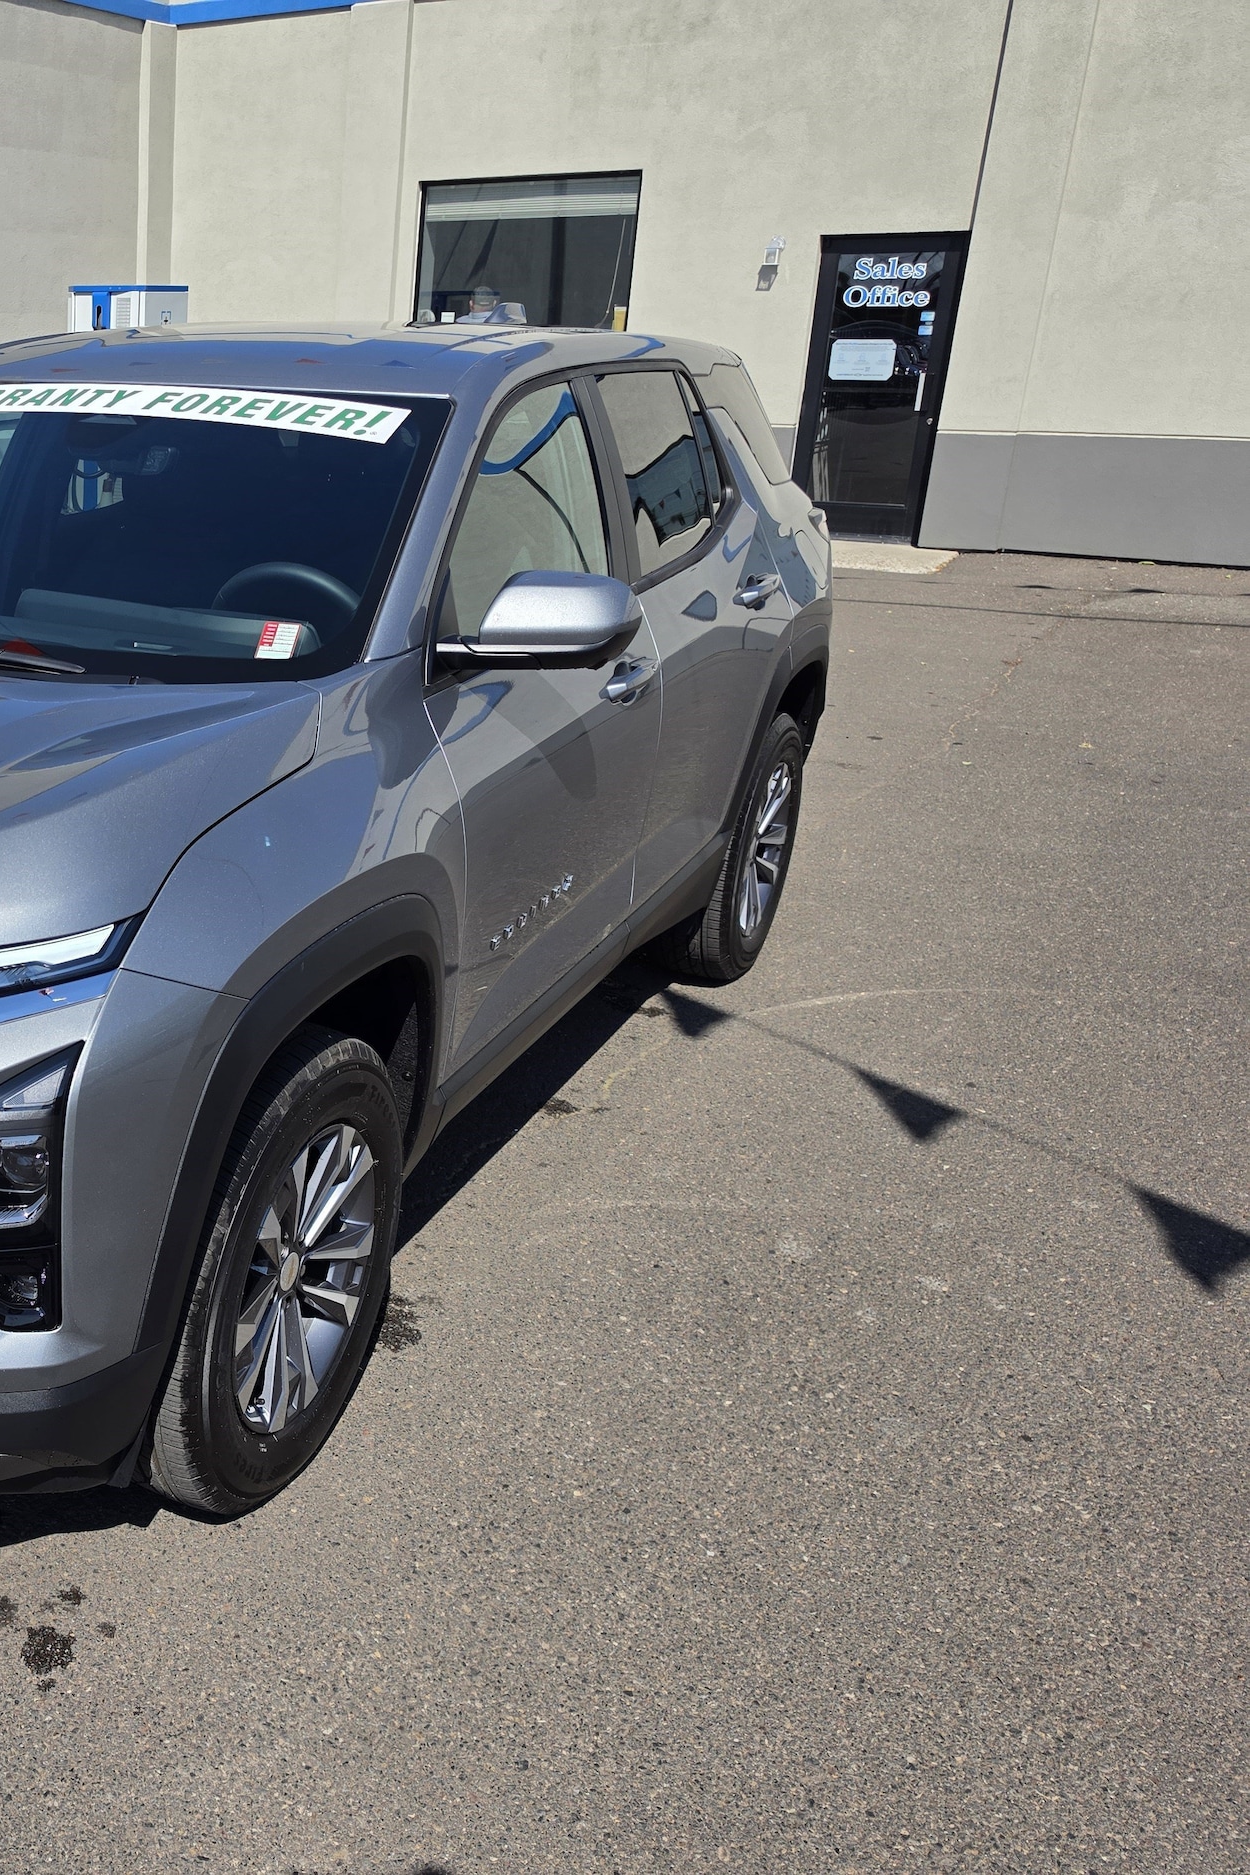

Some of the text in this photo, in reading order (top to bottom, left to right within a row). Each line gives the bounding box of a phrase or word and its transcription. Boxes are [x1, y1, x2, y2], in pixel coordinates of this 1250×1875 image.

[854, 257, 928, 280] Sales
[843, 285, 930, 307] Office
[141, 391, 393, 436] FOREVER!
